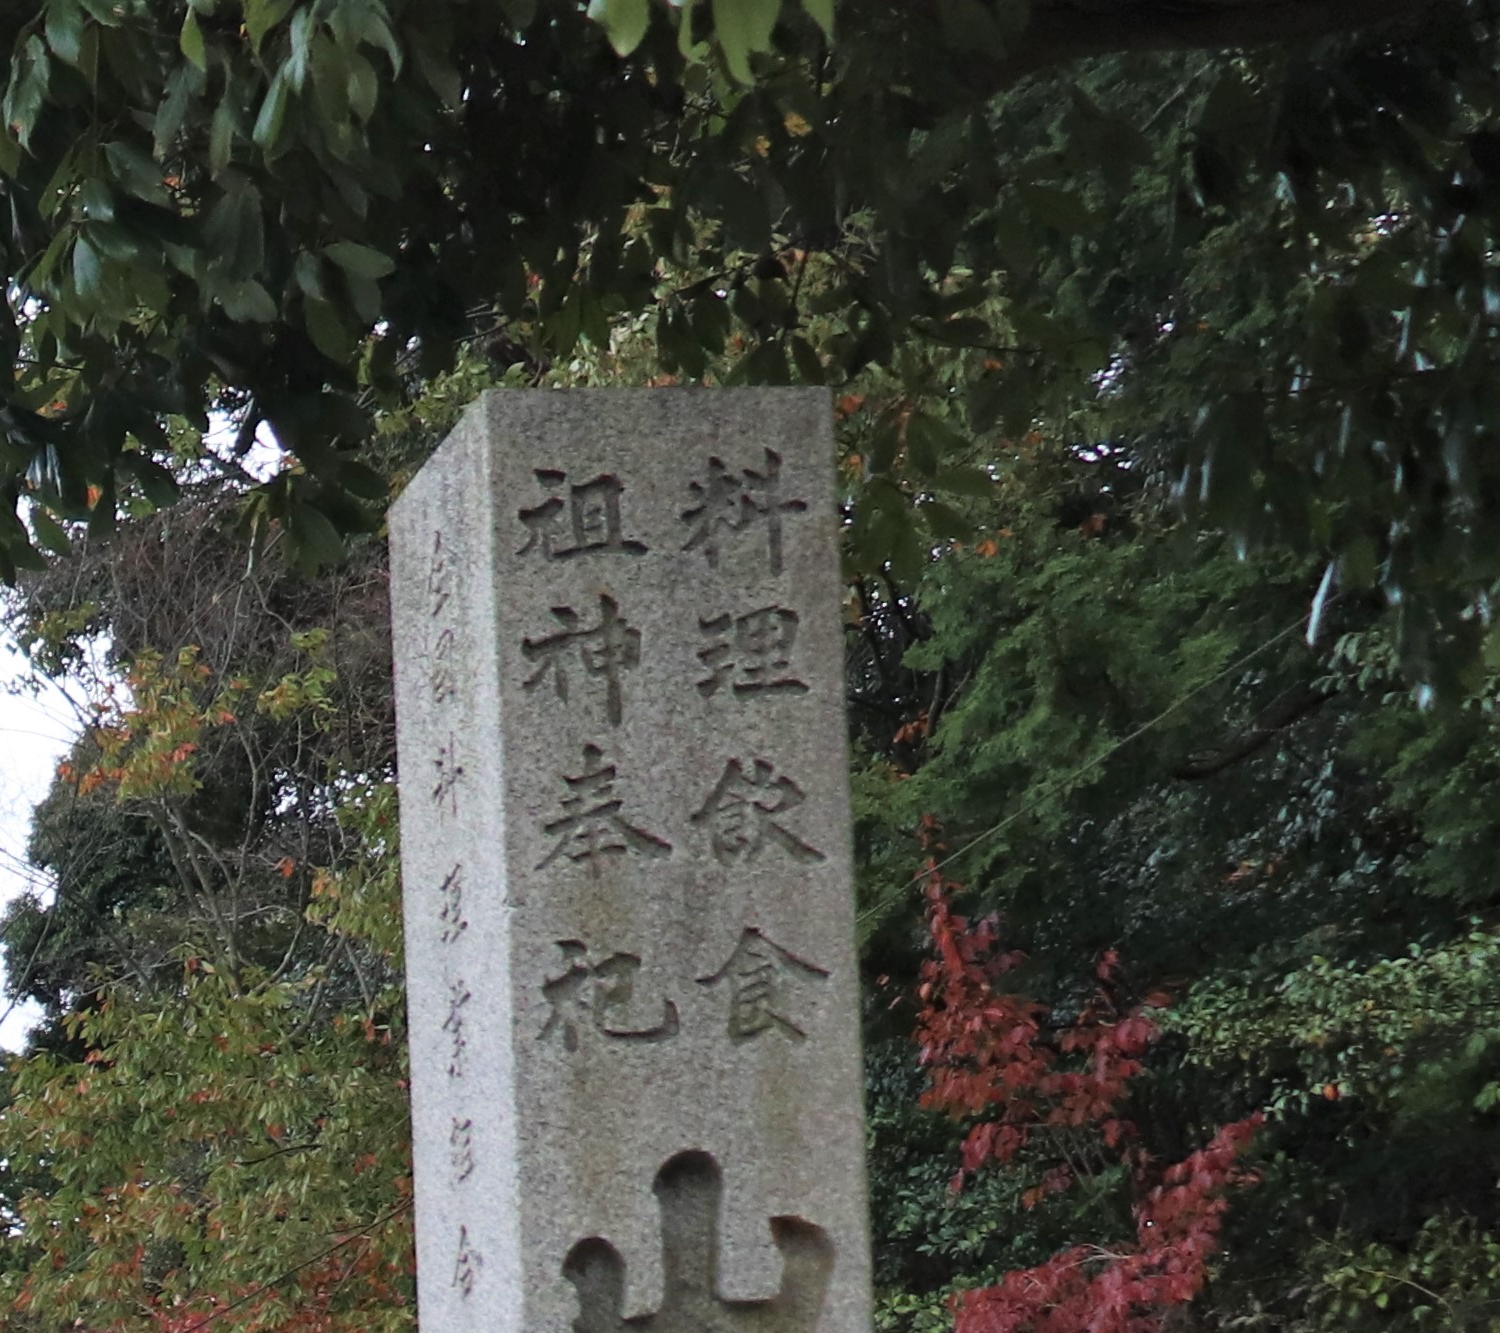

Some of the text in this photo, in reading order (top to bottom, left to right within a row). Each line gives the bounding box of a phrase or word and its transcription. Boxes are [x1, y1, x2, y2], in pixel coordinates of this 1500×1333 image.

[516, 467, 679, 1053] 祖神奉祀
[681, 447, 833, 1045] 料理飲食
